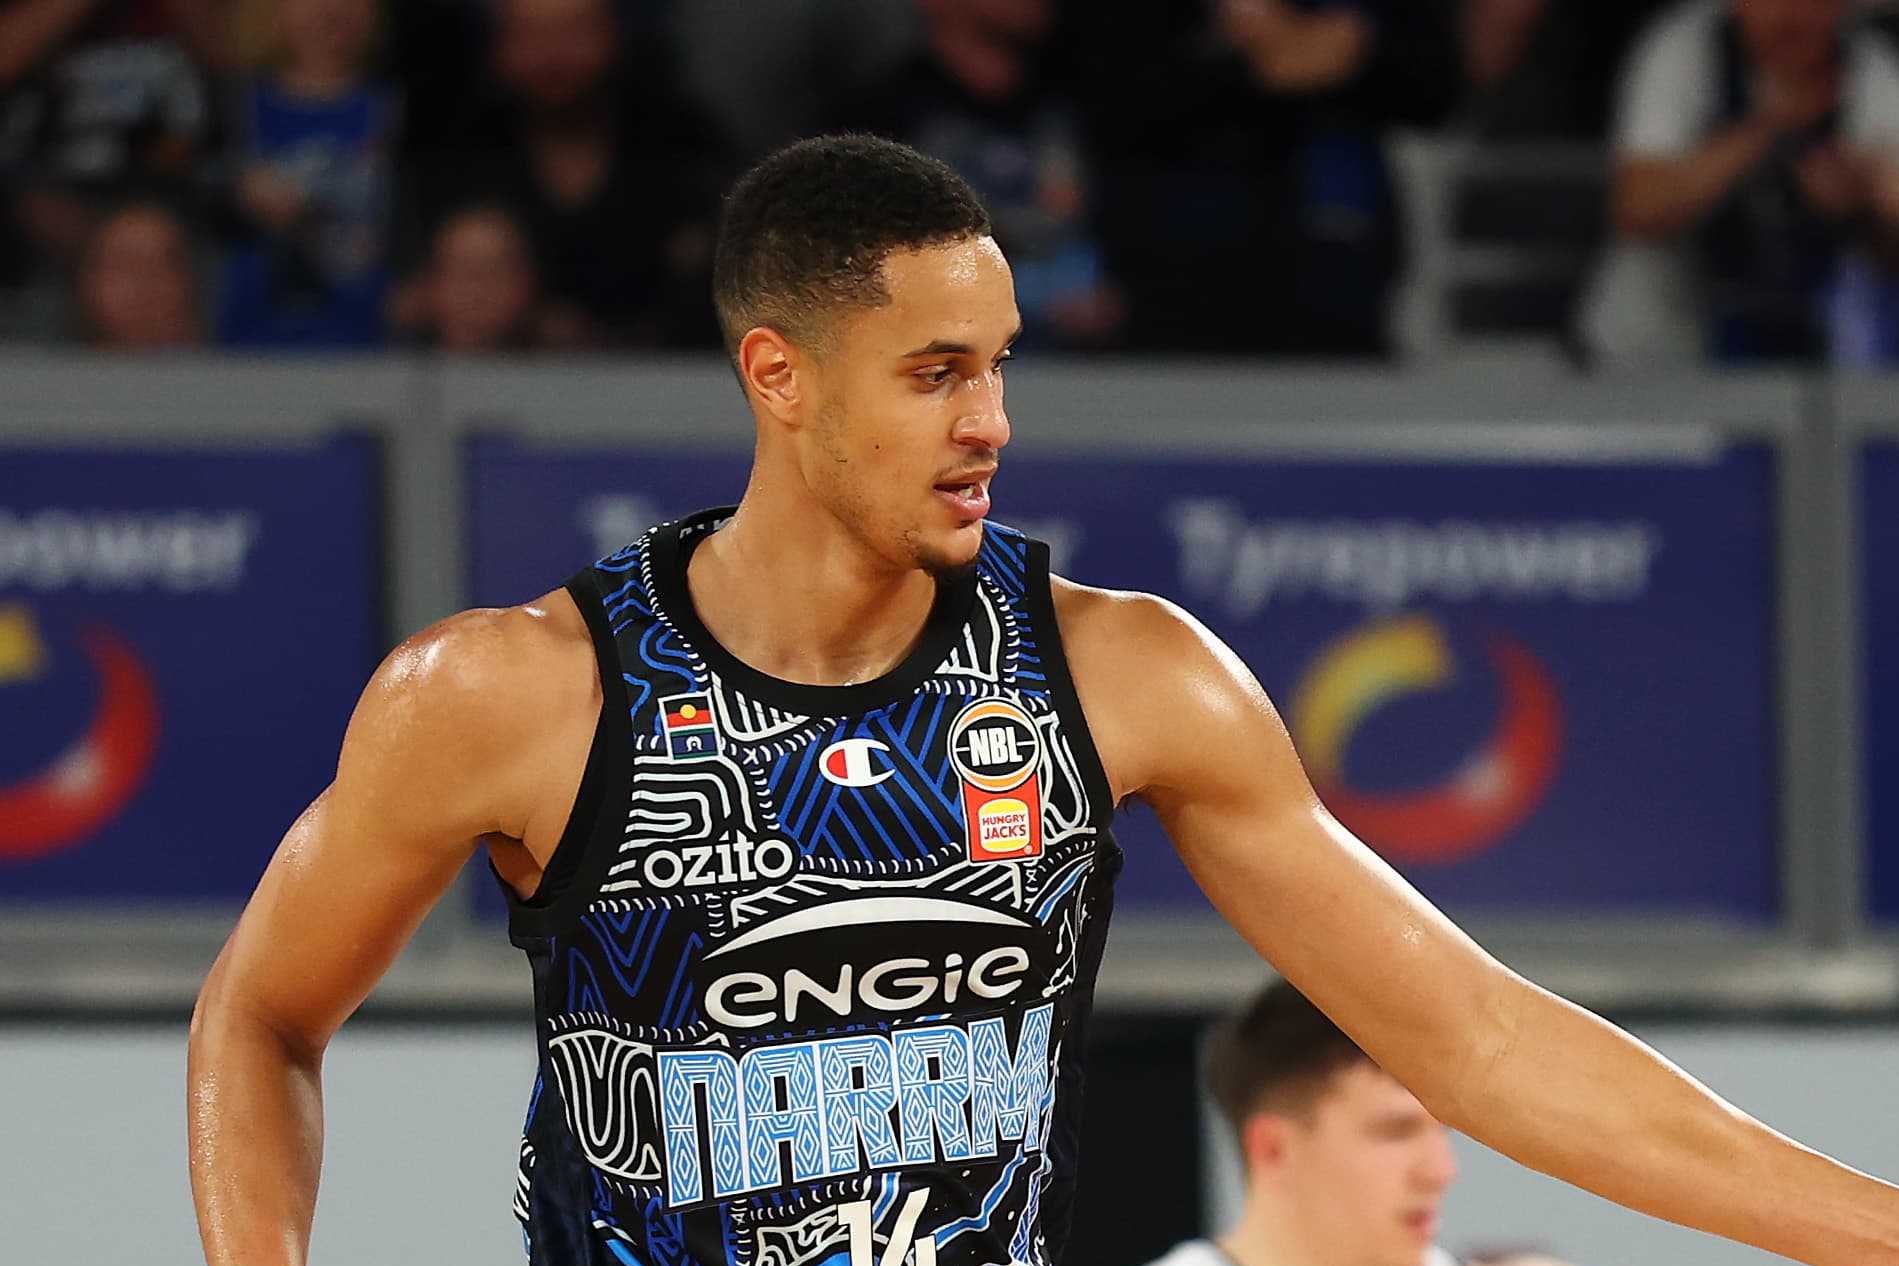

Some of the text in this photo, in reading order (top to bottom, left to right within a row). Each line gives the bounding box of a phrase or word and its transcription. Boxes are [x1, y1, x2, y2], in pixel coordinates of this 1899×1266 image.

[967, 726, 1024, 767] NBL
[982, 813, 1026, 826] HUNGRY
[643, 828, 795, 889] ozito
[655, 1001, 1056, 1208] NARRM
